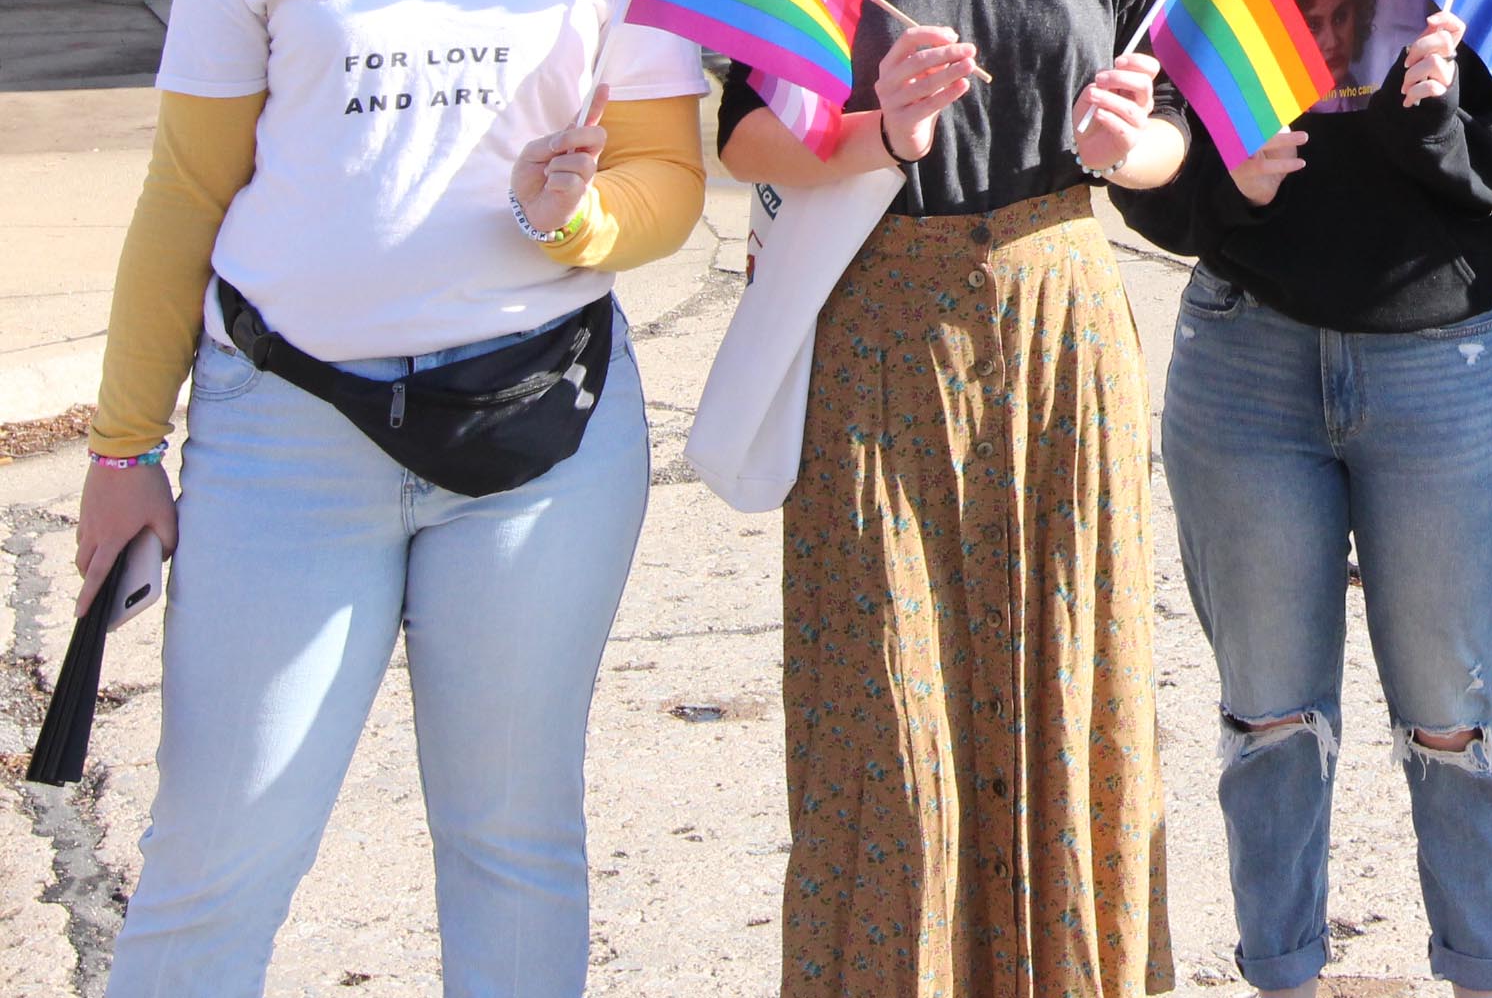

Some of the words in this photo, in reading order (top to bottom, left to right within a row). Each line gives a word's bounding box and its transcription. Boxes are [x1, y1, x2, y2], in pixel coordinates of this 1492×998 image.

[344, 52, 408, 73] FOR
[427, 47, 510, 66] LOVE
[344, 93, 413, 115] AND
[430, 89, 501, 108] ART.
[1339, 85, 1357, 98] who
